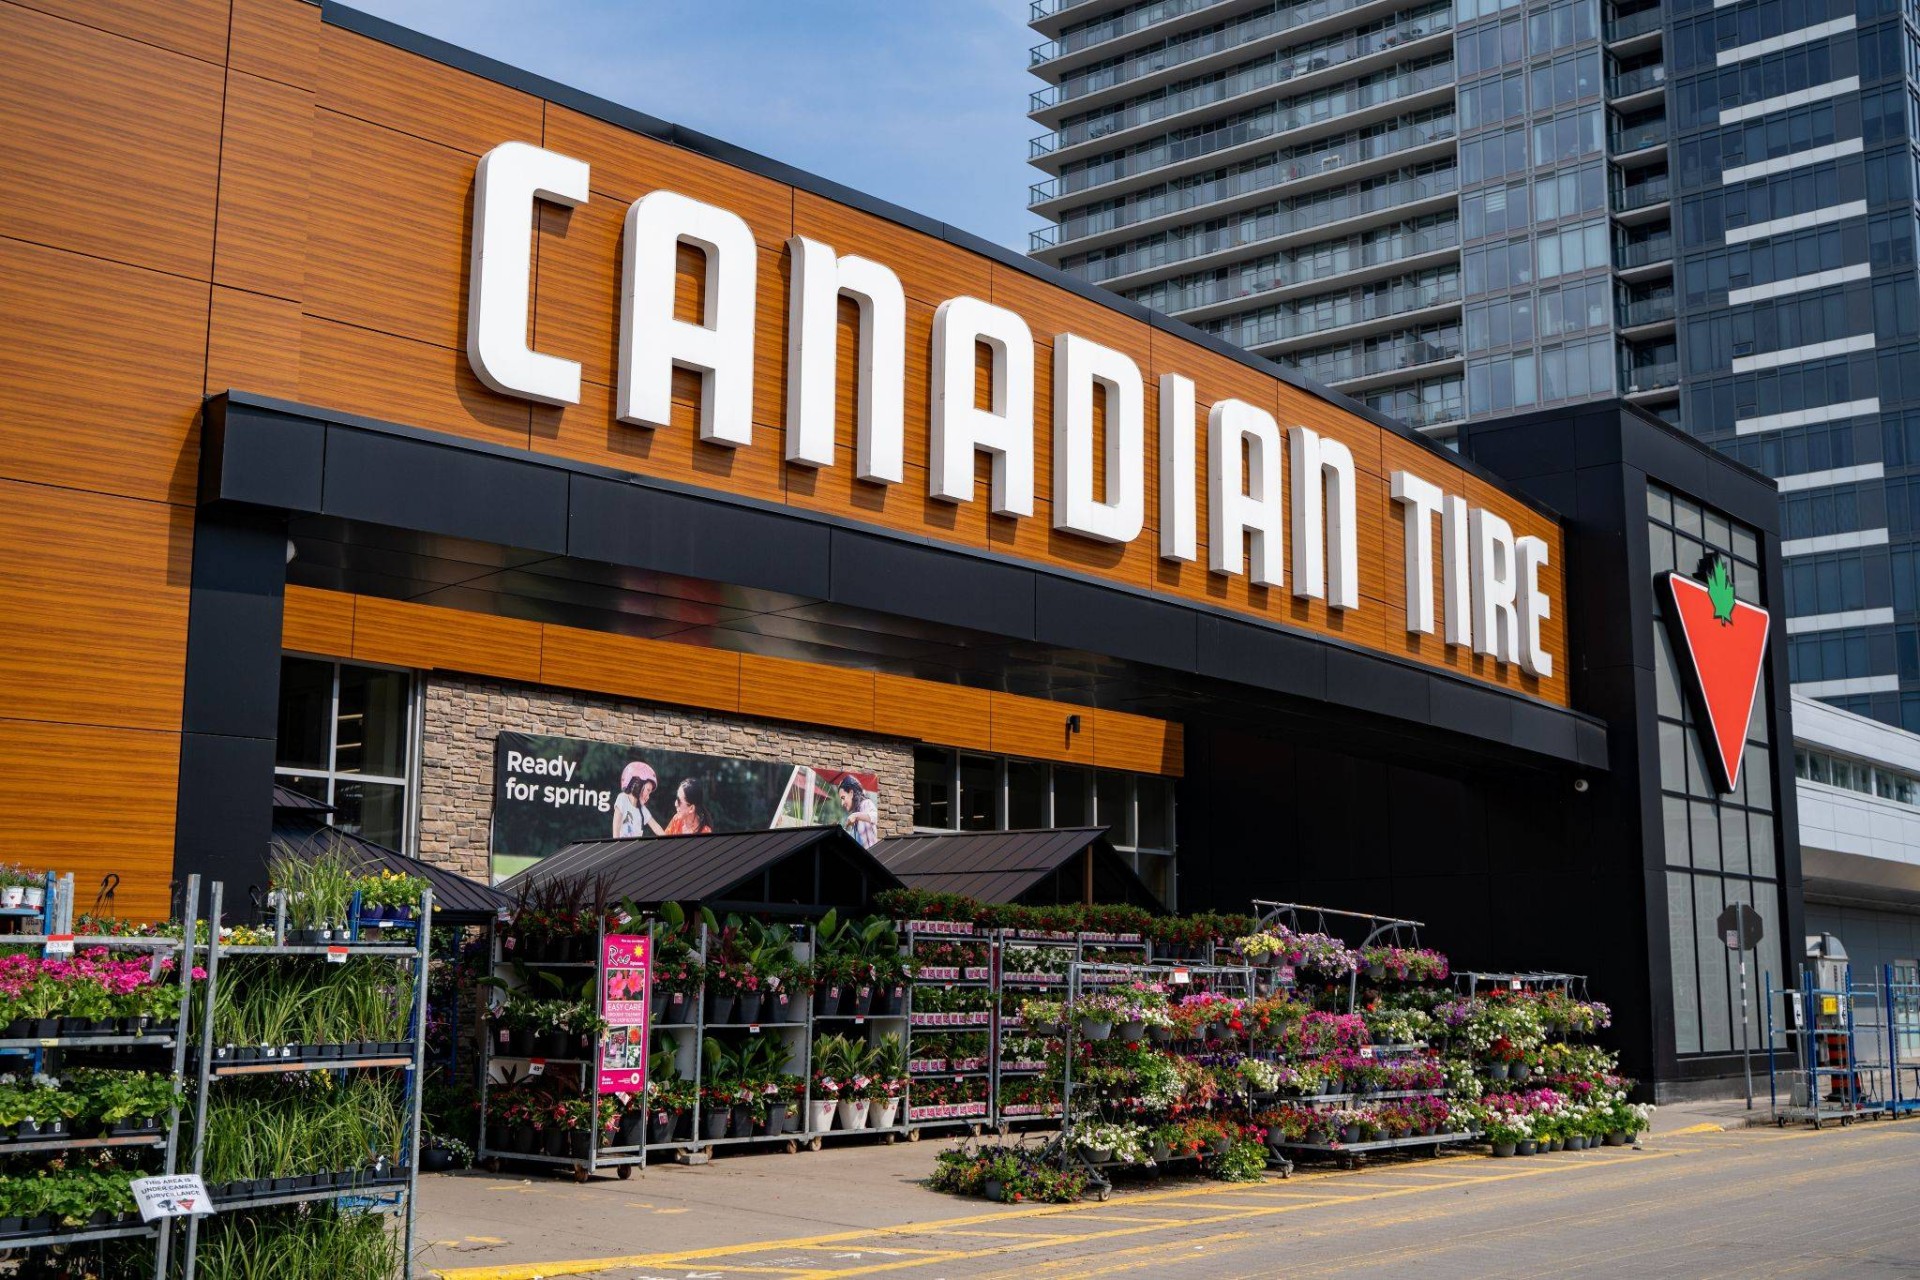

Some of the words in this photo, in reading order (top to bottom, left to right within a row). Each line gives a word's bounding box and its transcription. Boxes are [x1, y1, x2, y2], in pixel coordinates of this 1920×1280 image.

[1390, 471, 1552, 678] TIRE
[507, 751, 577, 782] Ready
[506, 777, 539, 801] for
[544, 784, 611, 812] spring
[608, 1003, 623, 1011] EASY
[624, 1003, 642, 1011] CARE
[141, 1185, 168, 1195] UNDER
[168, 1183, 200, 1191] CAMERA
